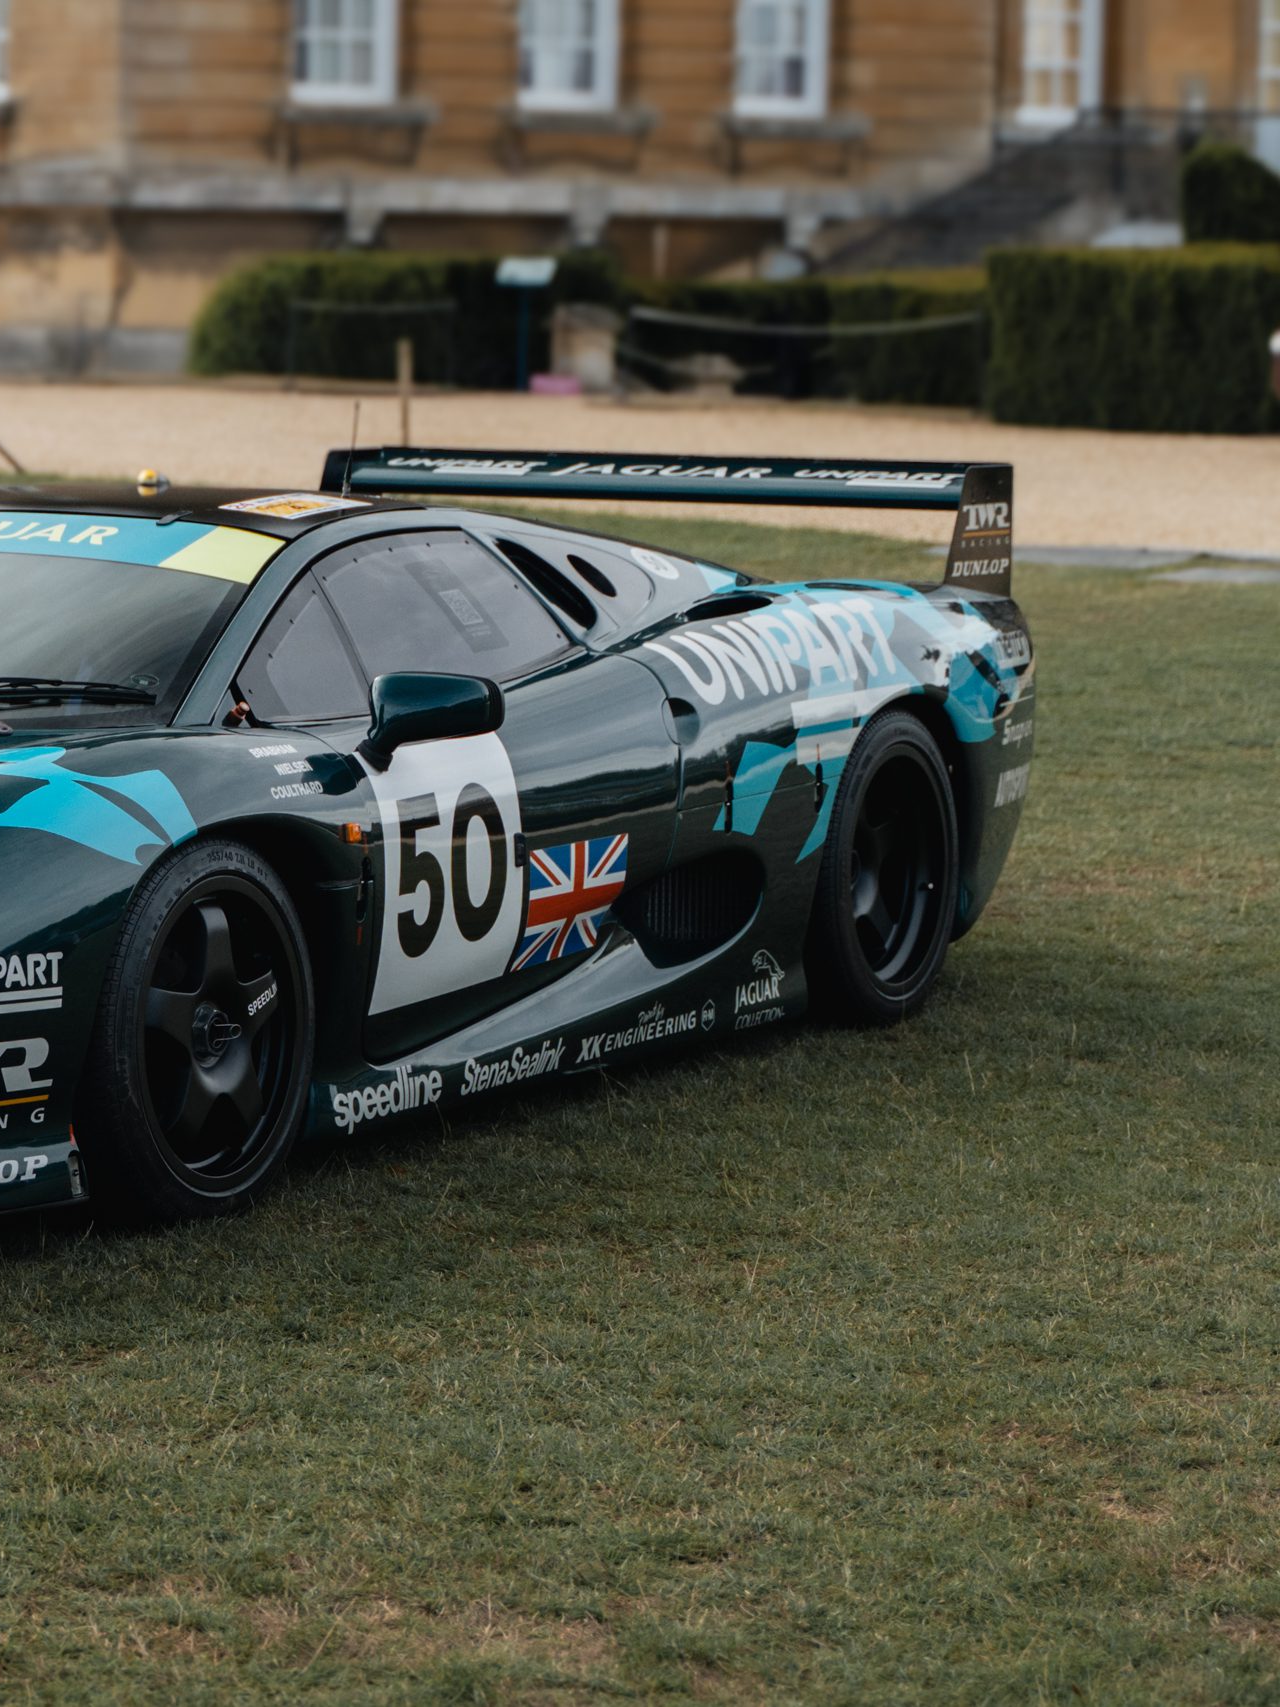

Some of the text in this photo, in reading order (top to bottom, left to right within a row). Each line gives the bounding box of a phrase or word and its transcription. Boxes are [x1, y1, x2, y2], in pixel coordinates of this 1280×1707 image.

[387, 457, 548, 476] UNIPART
[549, 463, 772, 479] JAGUAR
[963, 502, 1011, 530] TWR
[951, 558, 1010, 578] DUNLOP
[643, 601, 896, 706] UNIPART
[273, 760, 314, 776] NIELSEN
[270, 780, 324, 800] COULTHARD
[396, 782, 508, 959] 50
[734, 977, 780, 1014] JAGUAR
[576, 1010, 697, 1064] XK ENGINEERING
[329, 1064, 443, 1135] speedline
